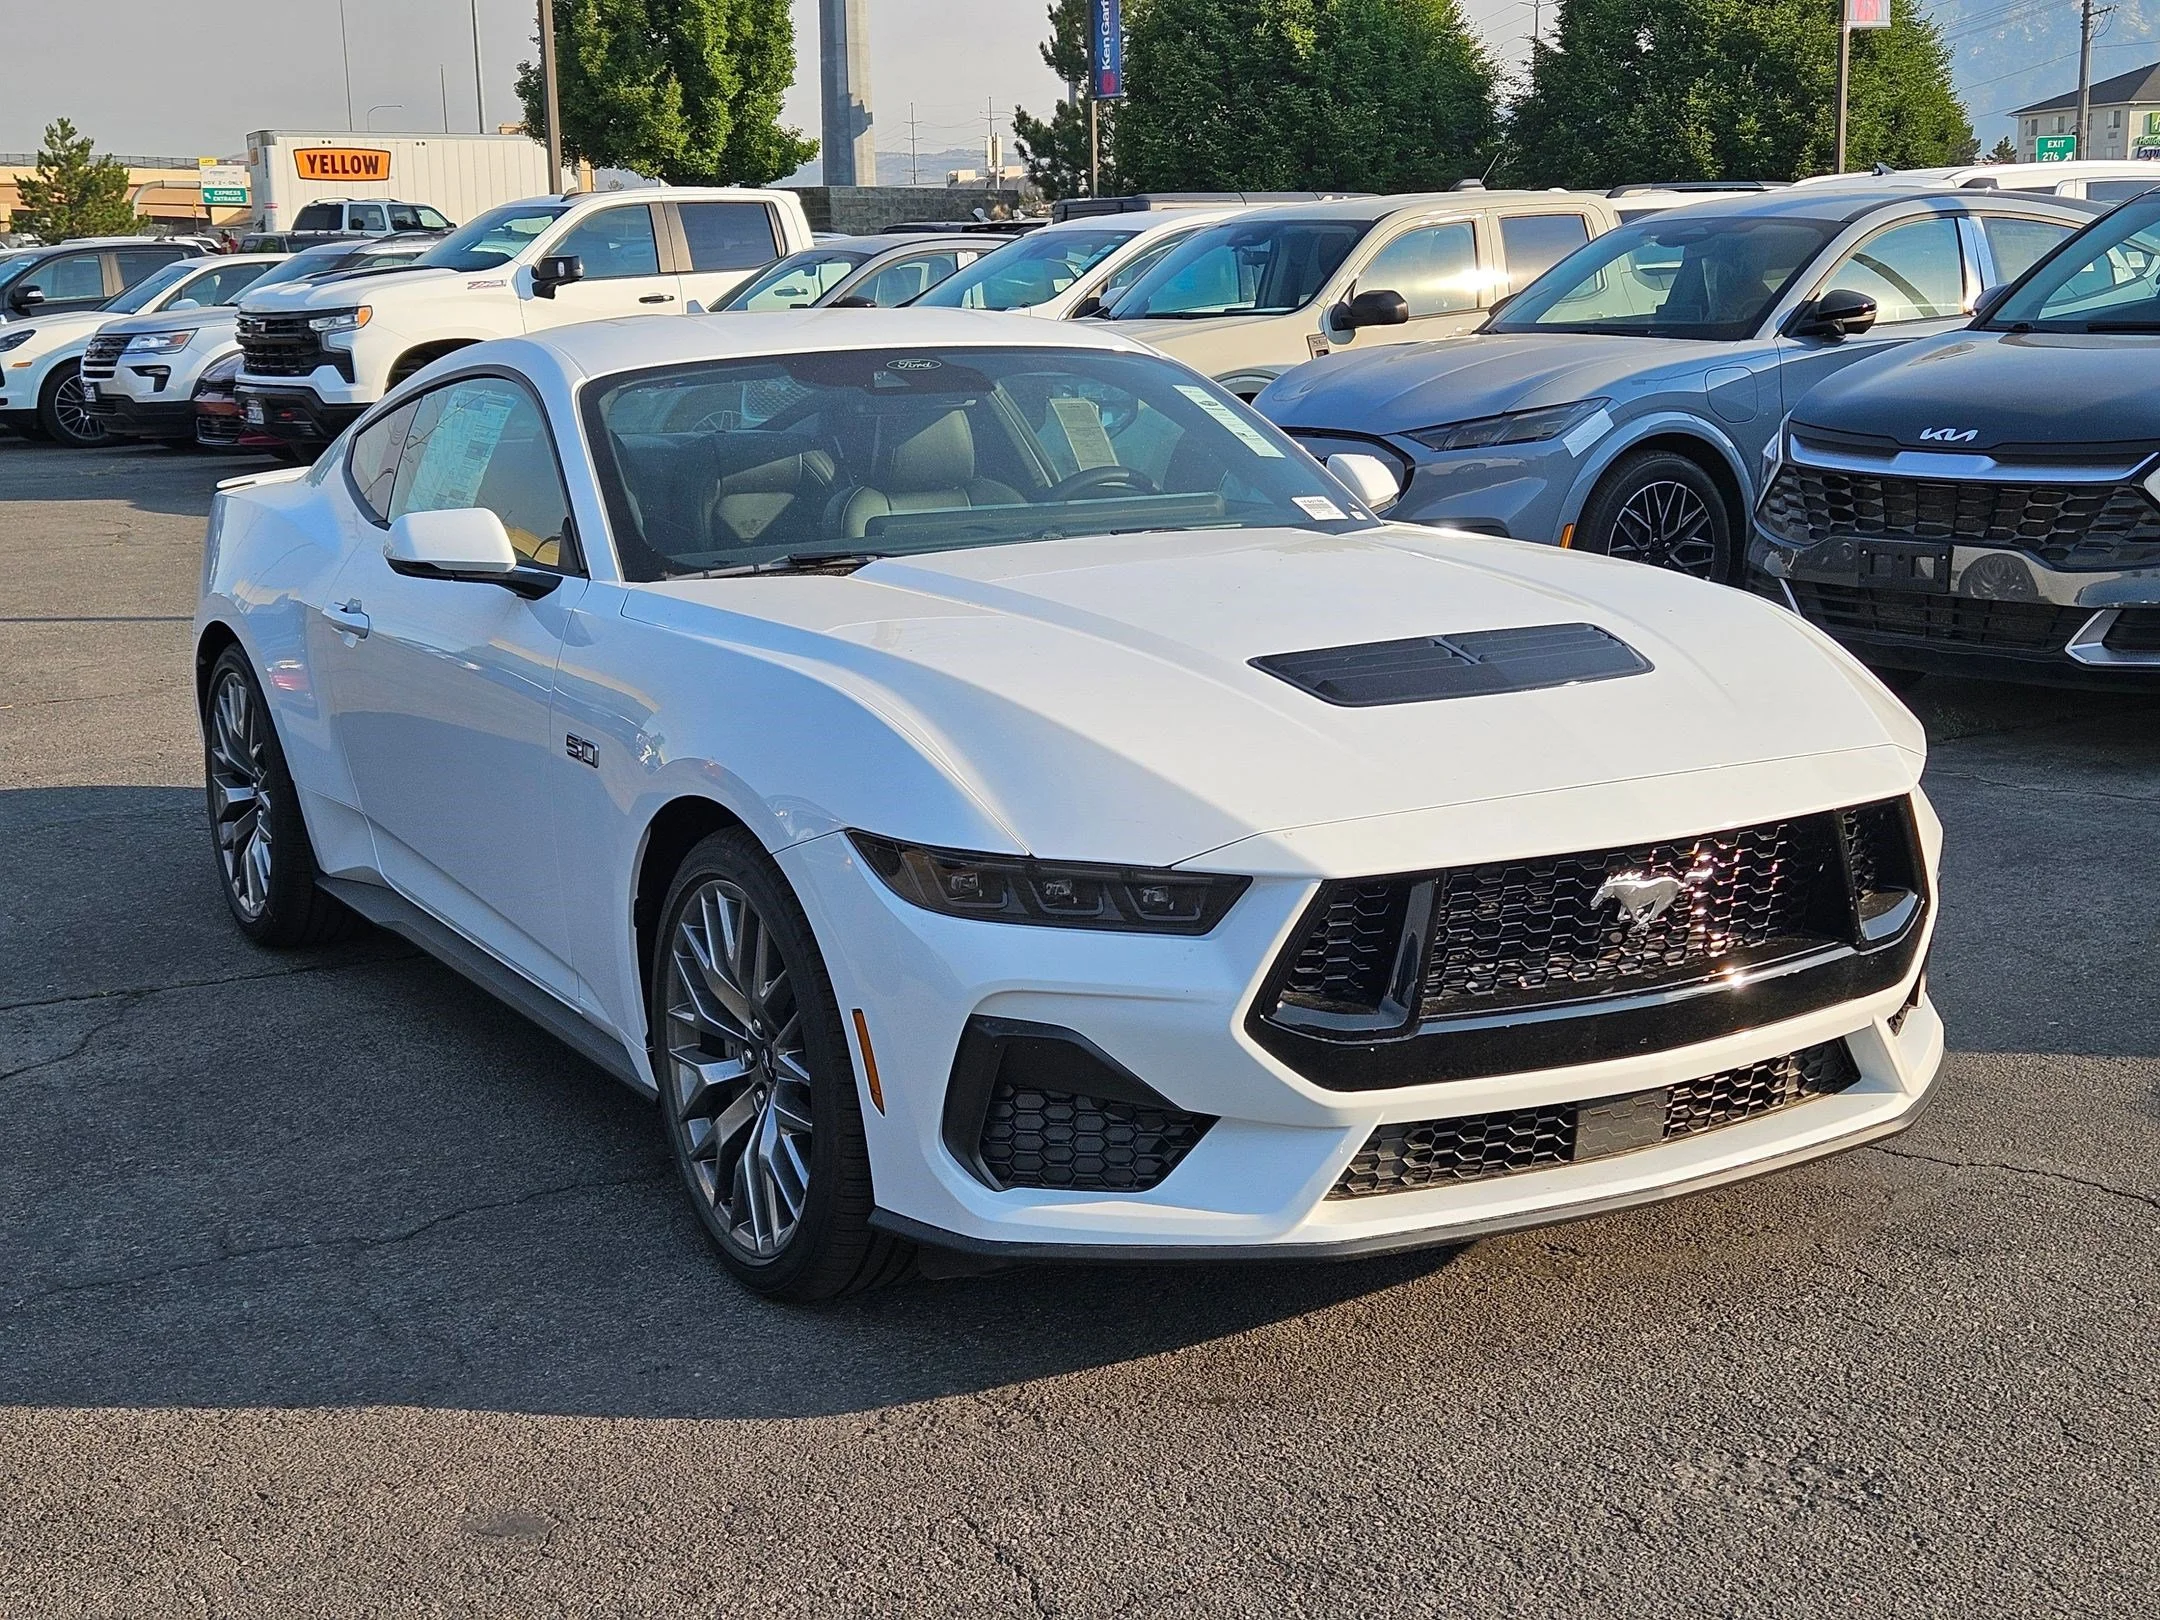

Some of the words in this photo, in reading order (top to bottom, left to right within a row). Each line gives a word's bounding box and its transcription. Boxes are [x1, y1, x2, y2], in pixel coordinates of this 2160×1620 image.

[1101, 37, 1111, 70] Ken
[2047, 139, 2066, 149] EXIT
[2042, 151, 2060, 162] 276
[306, 153, 380, 175] YELLOW
[897, 359, 933, 369] Ford
[1919, 427, 1979, 442] KIA
